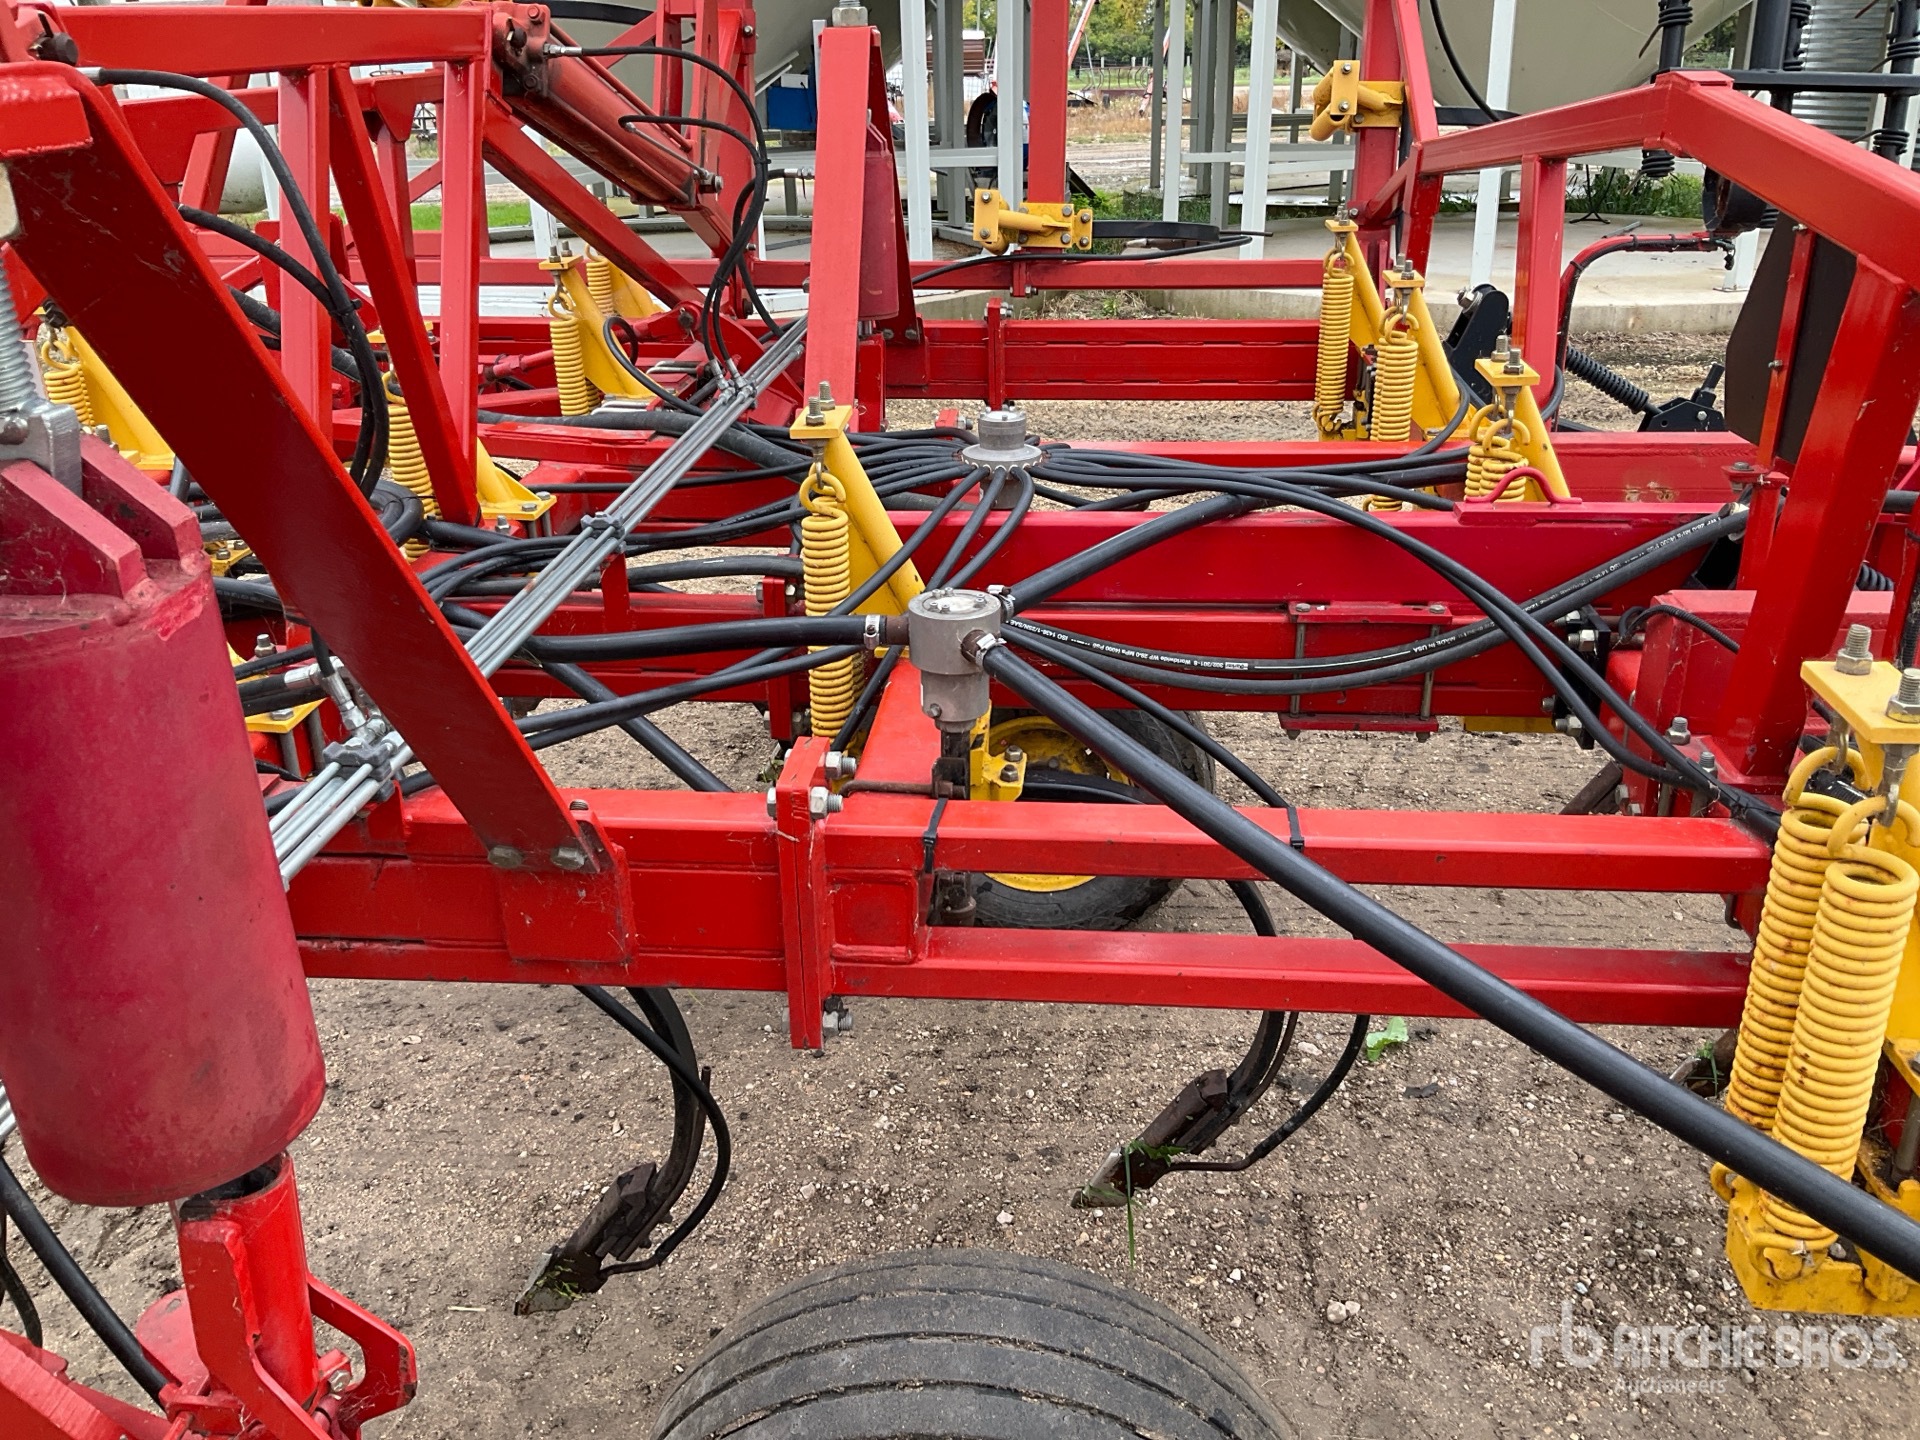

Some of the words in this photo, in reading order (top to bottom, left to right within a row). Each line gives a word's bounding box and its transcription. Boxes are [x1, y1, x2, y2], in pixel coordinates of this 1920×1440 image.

[1057, 633, 1068, 641] ISO
[1121, 649, 1135, 657] MPa
[1413, 645, 1427, 653] USA
[1160, 655, 1191, 665] Worldwide
